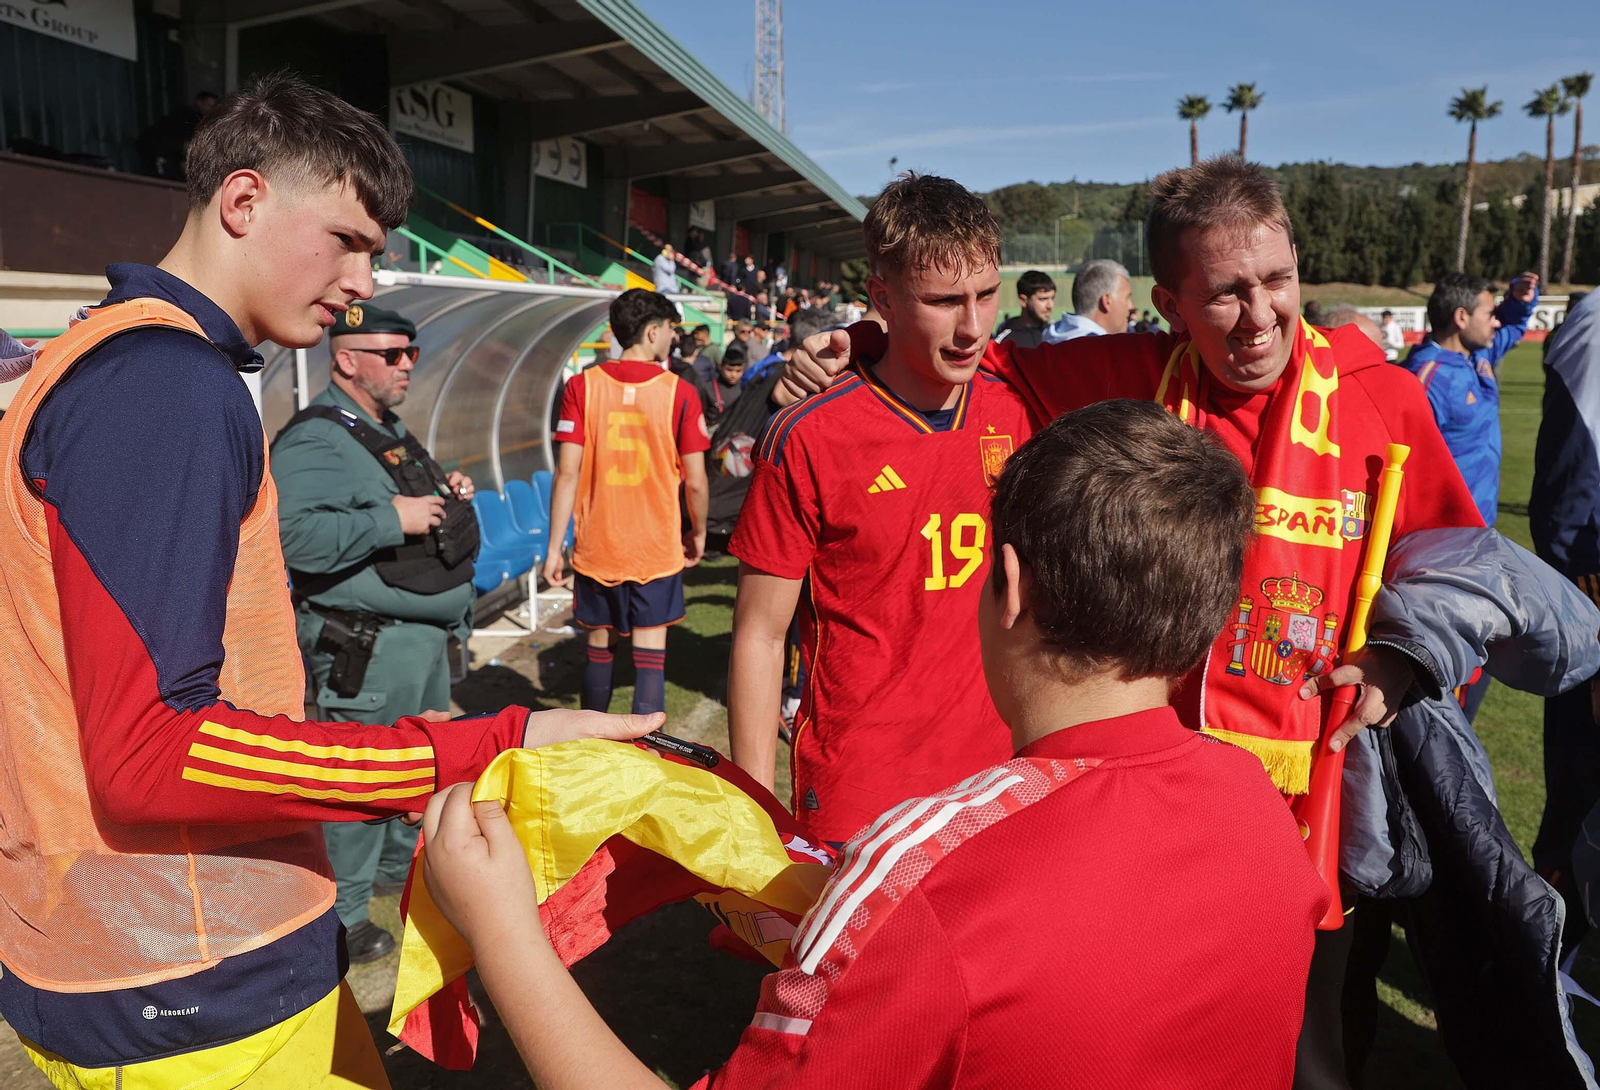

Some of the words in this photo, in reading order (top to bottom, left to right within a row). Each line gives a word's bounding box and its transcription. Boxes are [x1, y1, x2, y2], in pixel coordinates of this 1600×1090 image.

[0, 2, 26, 21] TS
[605, 411, 650, 487] 5
[1255, 503, 1344, 538] SPAÑ
[920, 513, 986, 591] 19
[159, 1005, 200, 1017] AEROREADY
